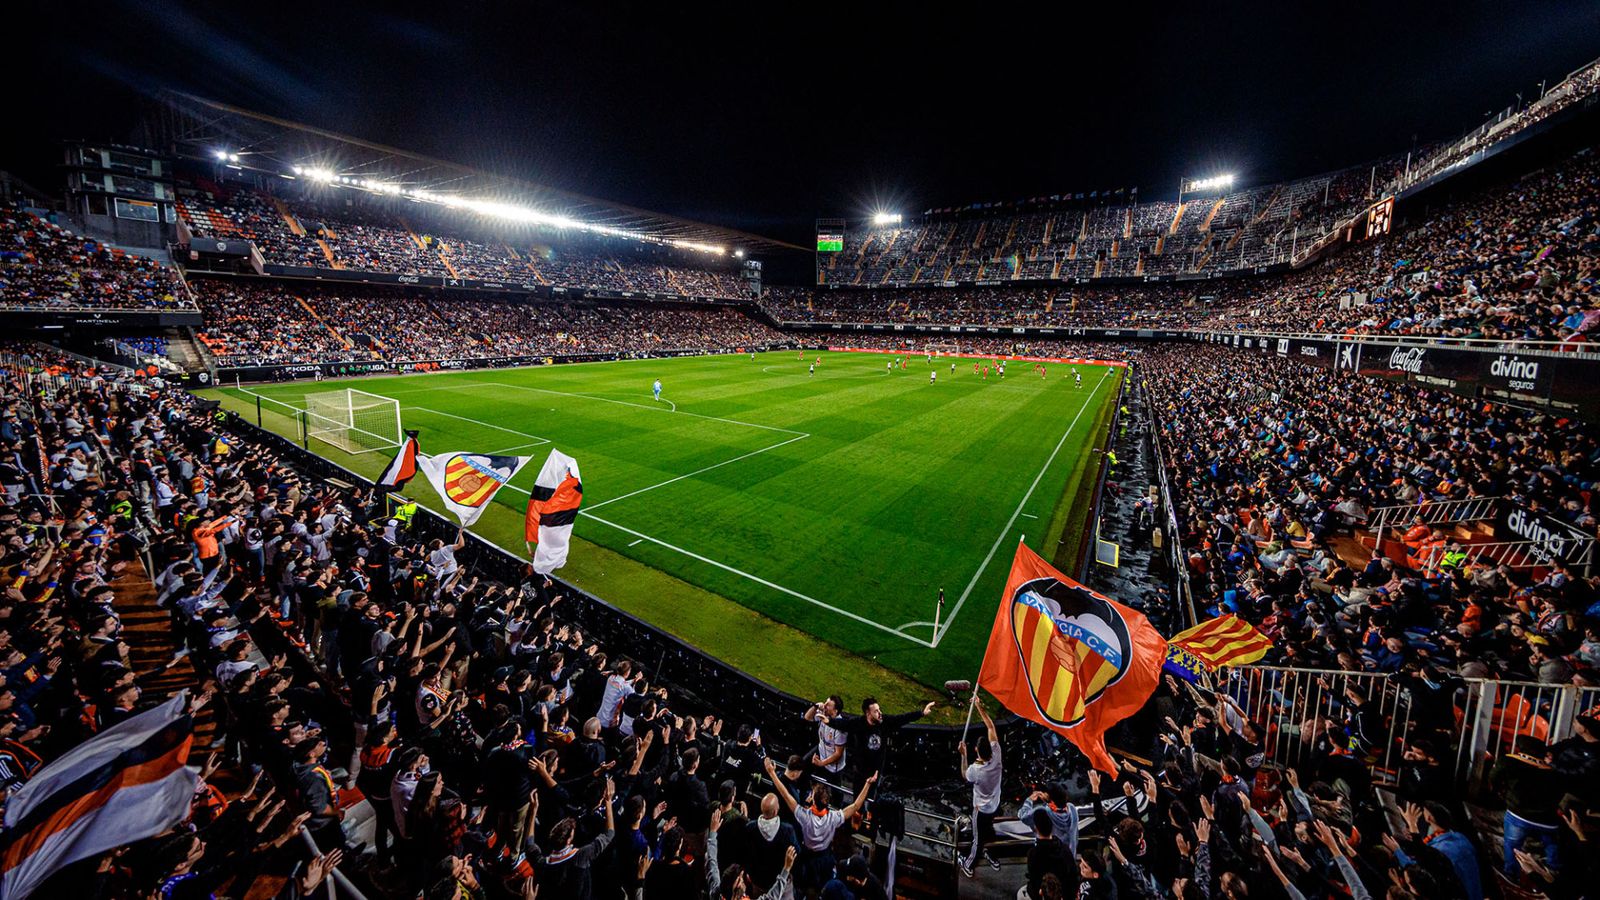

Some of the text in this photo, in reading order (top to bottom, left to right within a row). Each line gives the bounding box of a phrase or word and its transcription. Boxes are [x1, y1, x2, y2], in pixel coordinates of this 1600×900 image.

[1490, 356, 1539, 380] divina
[1508, 380, 1535, 391] seguros
[1508, 509, 1564, 557] divina
